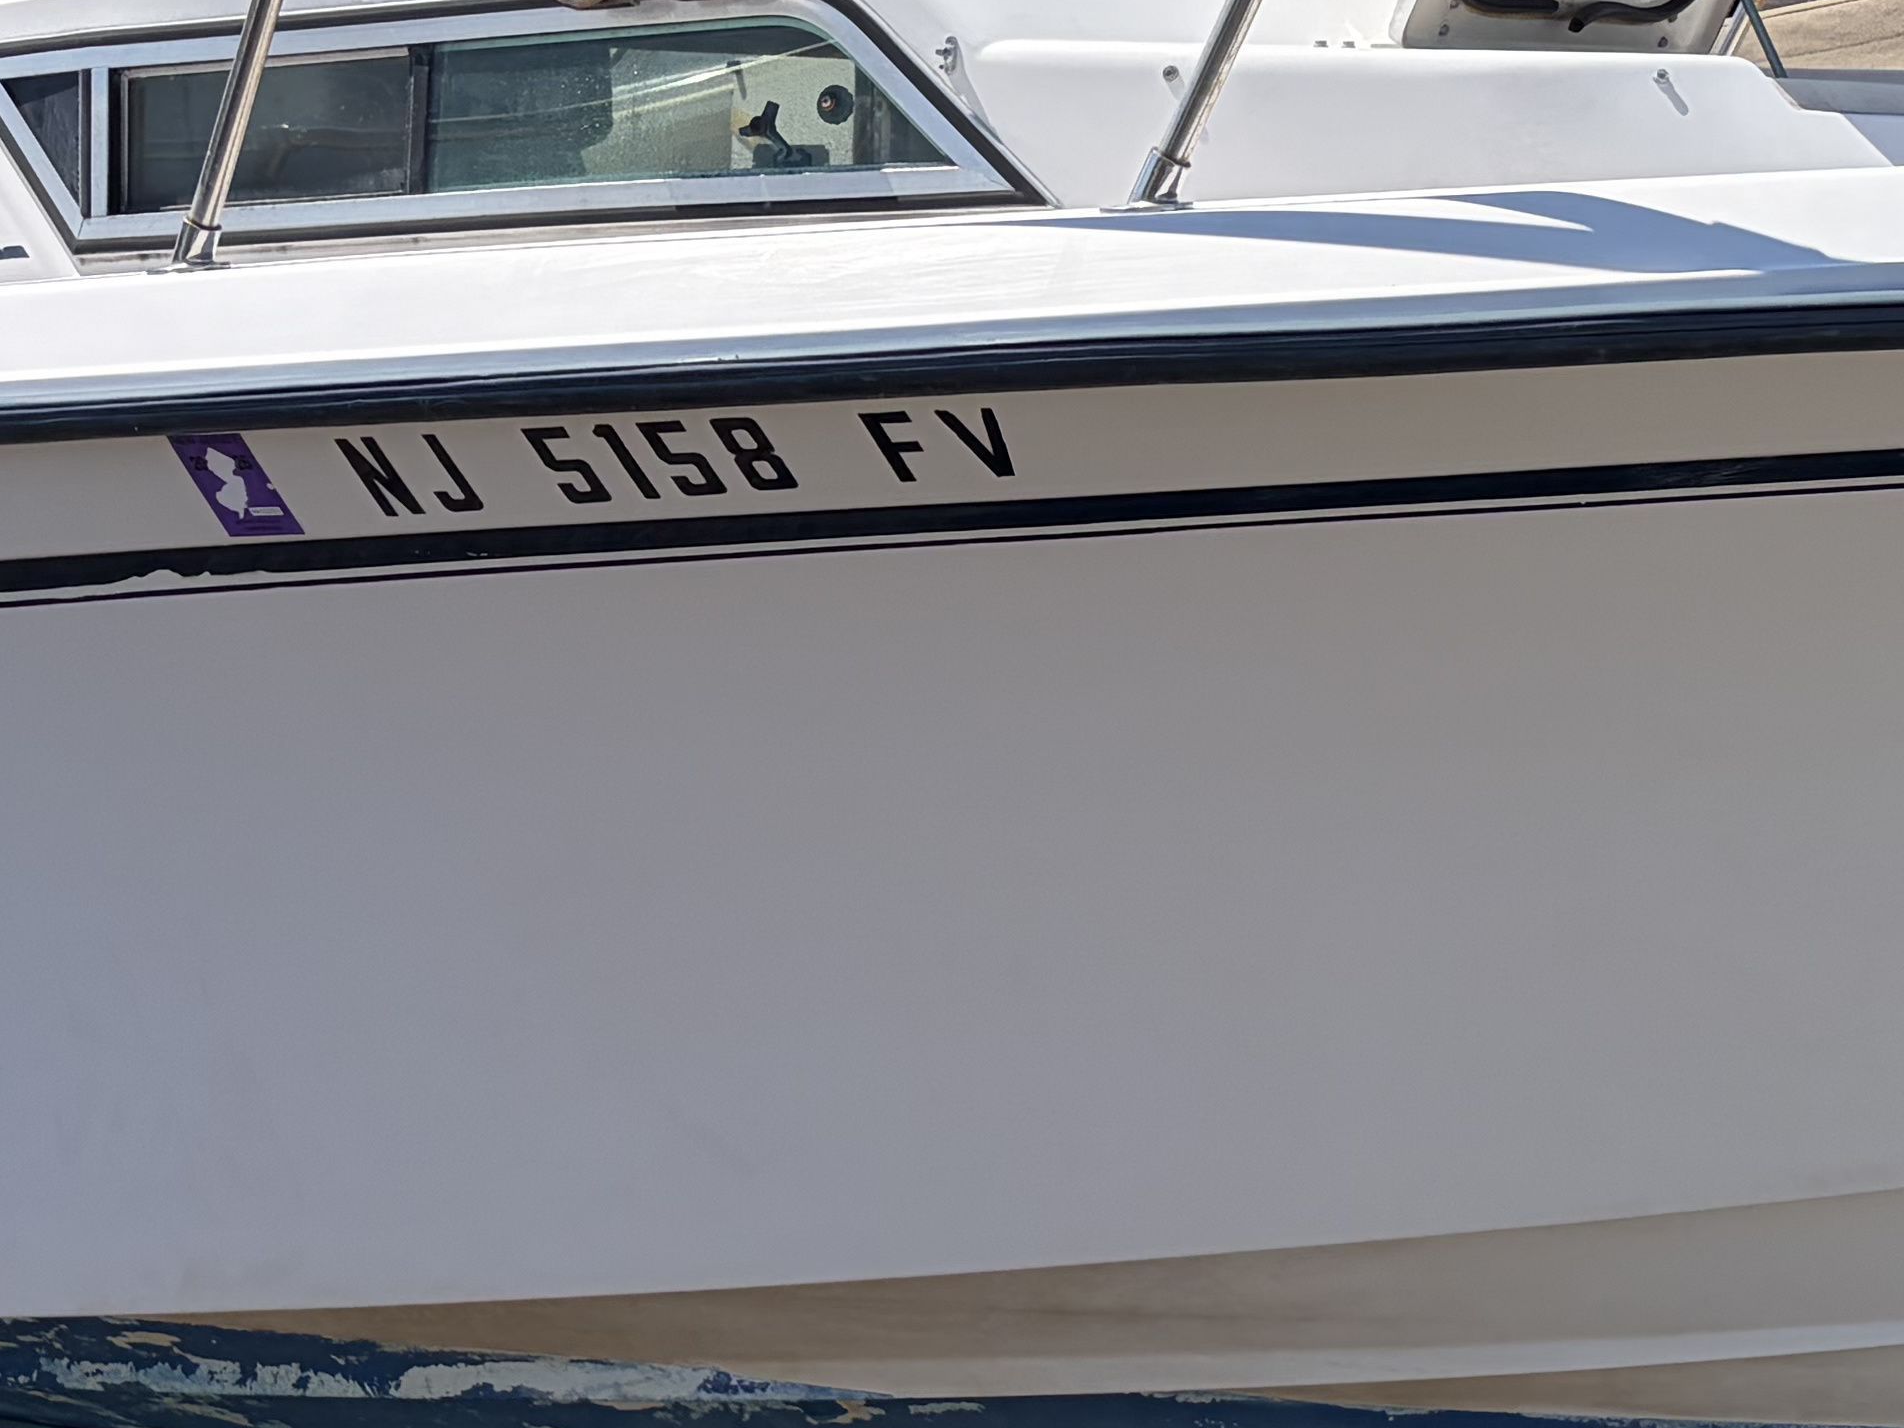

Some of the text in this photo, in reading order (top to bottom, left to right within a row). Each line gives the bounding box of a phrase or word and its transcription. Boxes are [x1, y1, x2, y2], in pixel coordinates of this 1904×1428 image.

[335, 408, 1015, 517] NJ 5158 FV
